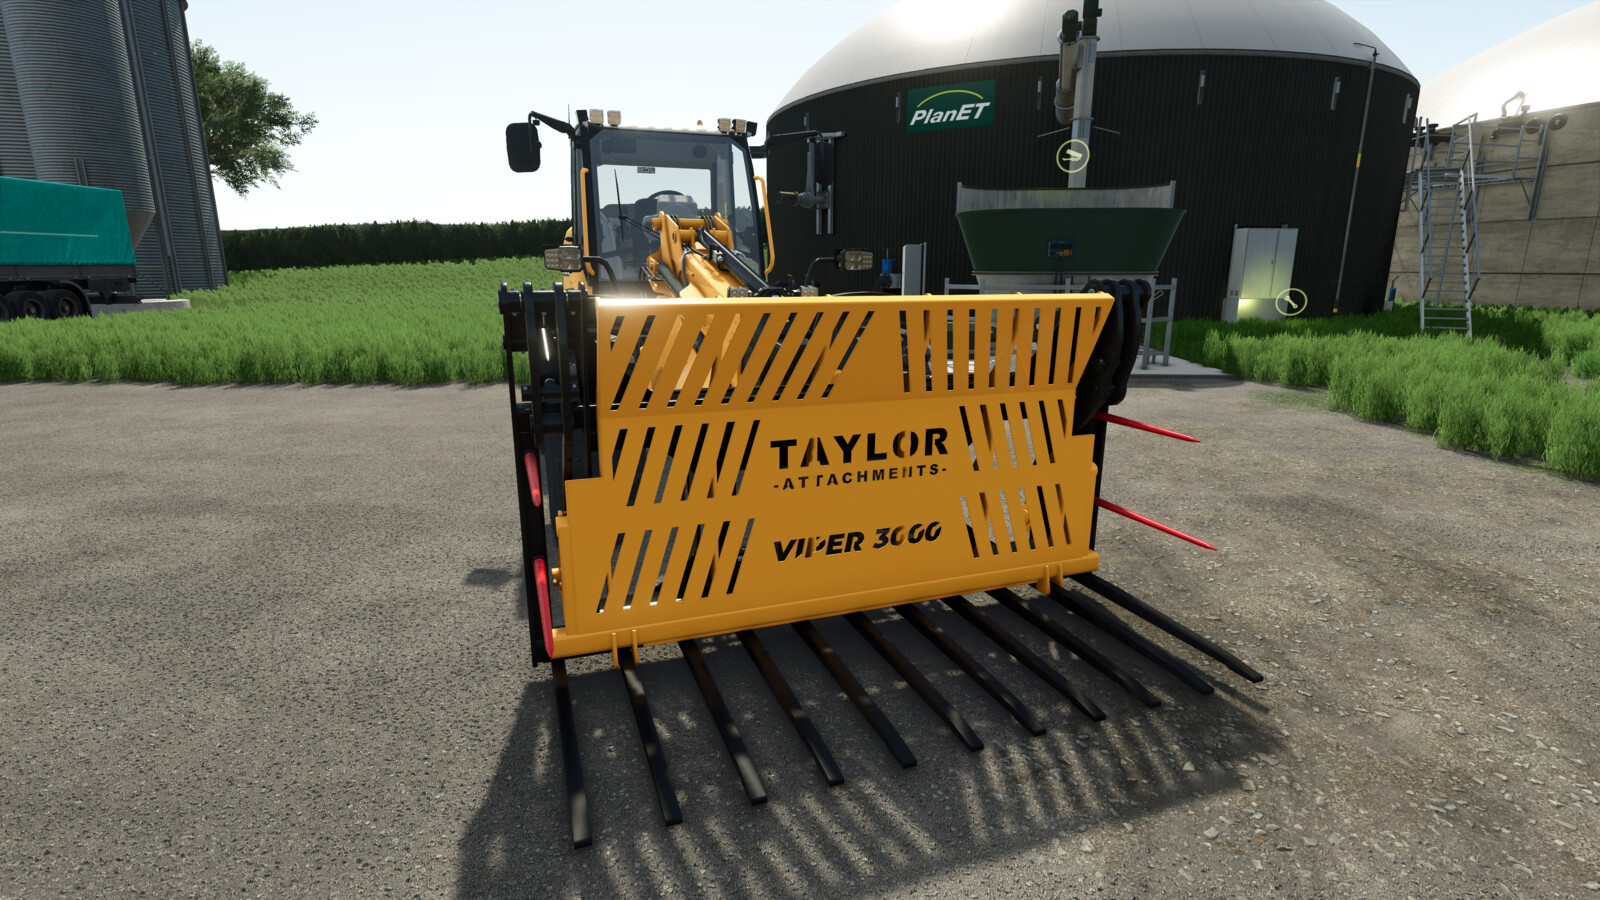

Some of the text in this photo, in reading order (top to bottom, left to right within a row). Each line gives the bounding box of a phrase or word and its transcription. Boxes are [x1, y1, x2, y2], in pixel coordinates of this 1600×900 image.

[909, 102, 991, 126] PlanET
[770, 428, 948, 469] TAYLOR
[773, 521, 942, 562] VIPER 3000
